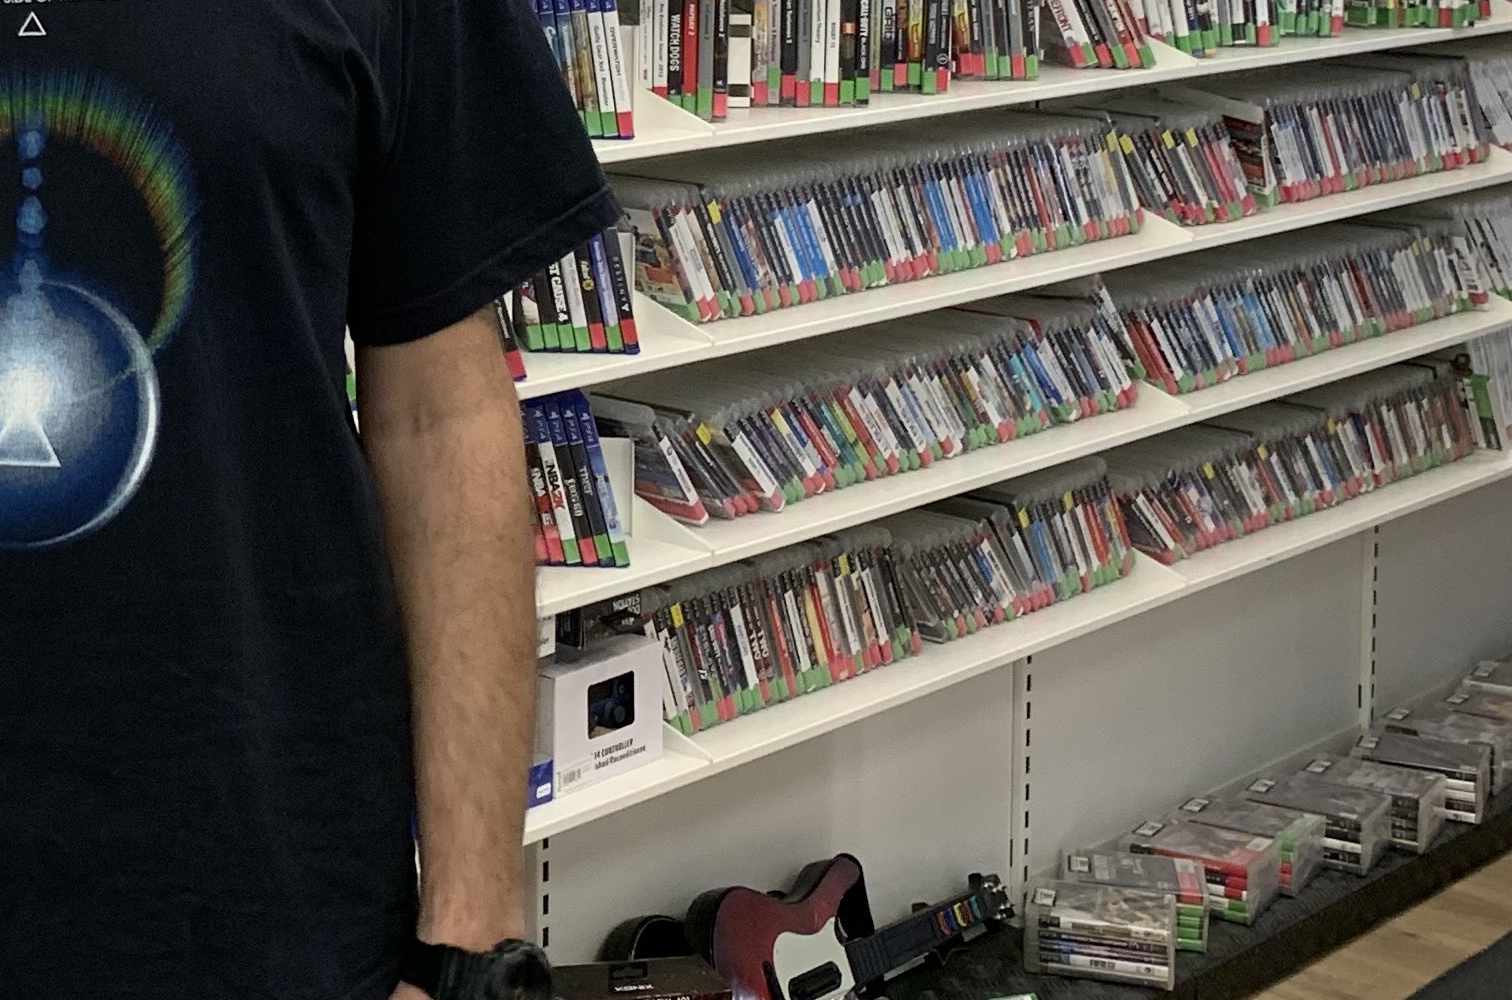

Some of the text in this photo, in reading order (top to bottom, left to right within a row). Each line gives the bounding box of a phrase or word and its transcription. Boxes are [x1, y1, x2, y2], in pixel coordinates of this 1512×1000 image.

[669, 14, 681, 72] WATCH DOGS
[546, 463, 560, 491] NBA
